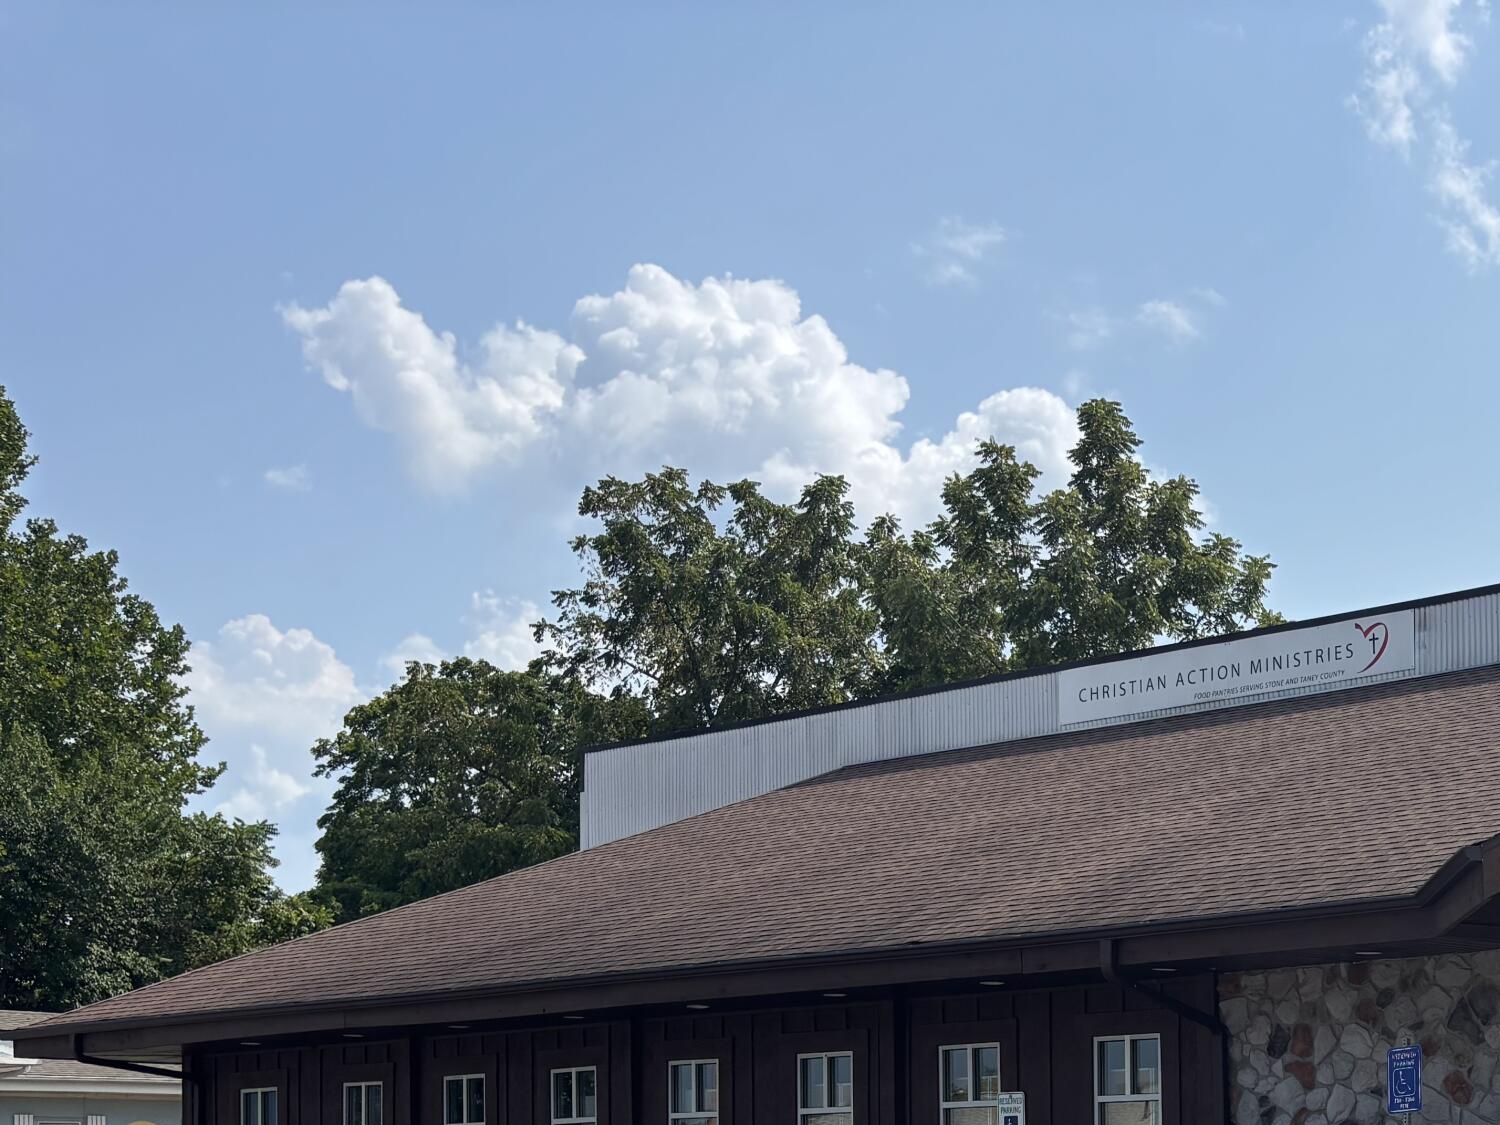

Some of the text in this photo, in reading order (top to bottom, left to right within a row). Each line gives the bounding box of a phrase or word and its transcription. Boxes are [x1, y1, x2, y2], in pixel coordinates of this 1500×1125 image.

[1078, 643, 1355, 703] CHRISTIAN ACTION MINISTRIES
[1193, 669, 1346, 701] FOOD PANTRIES SERVING STONE AND TANEY COUNTY
[1000, 1097, 1022, 1105] RESERVED
[1001, 1106, 1021, 1114] PARKING
